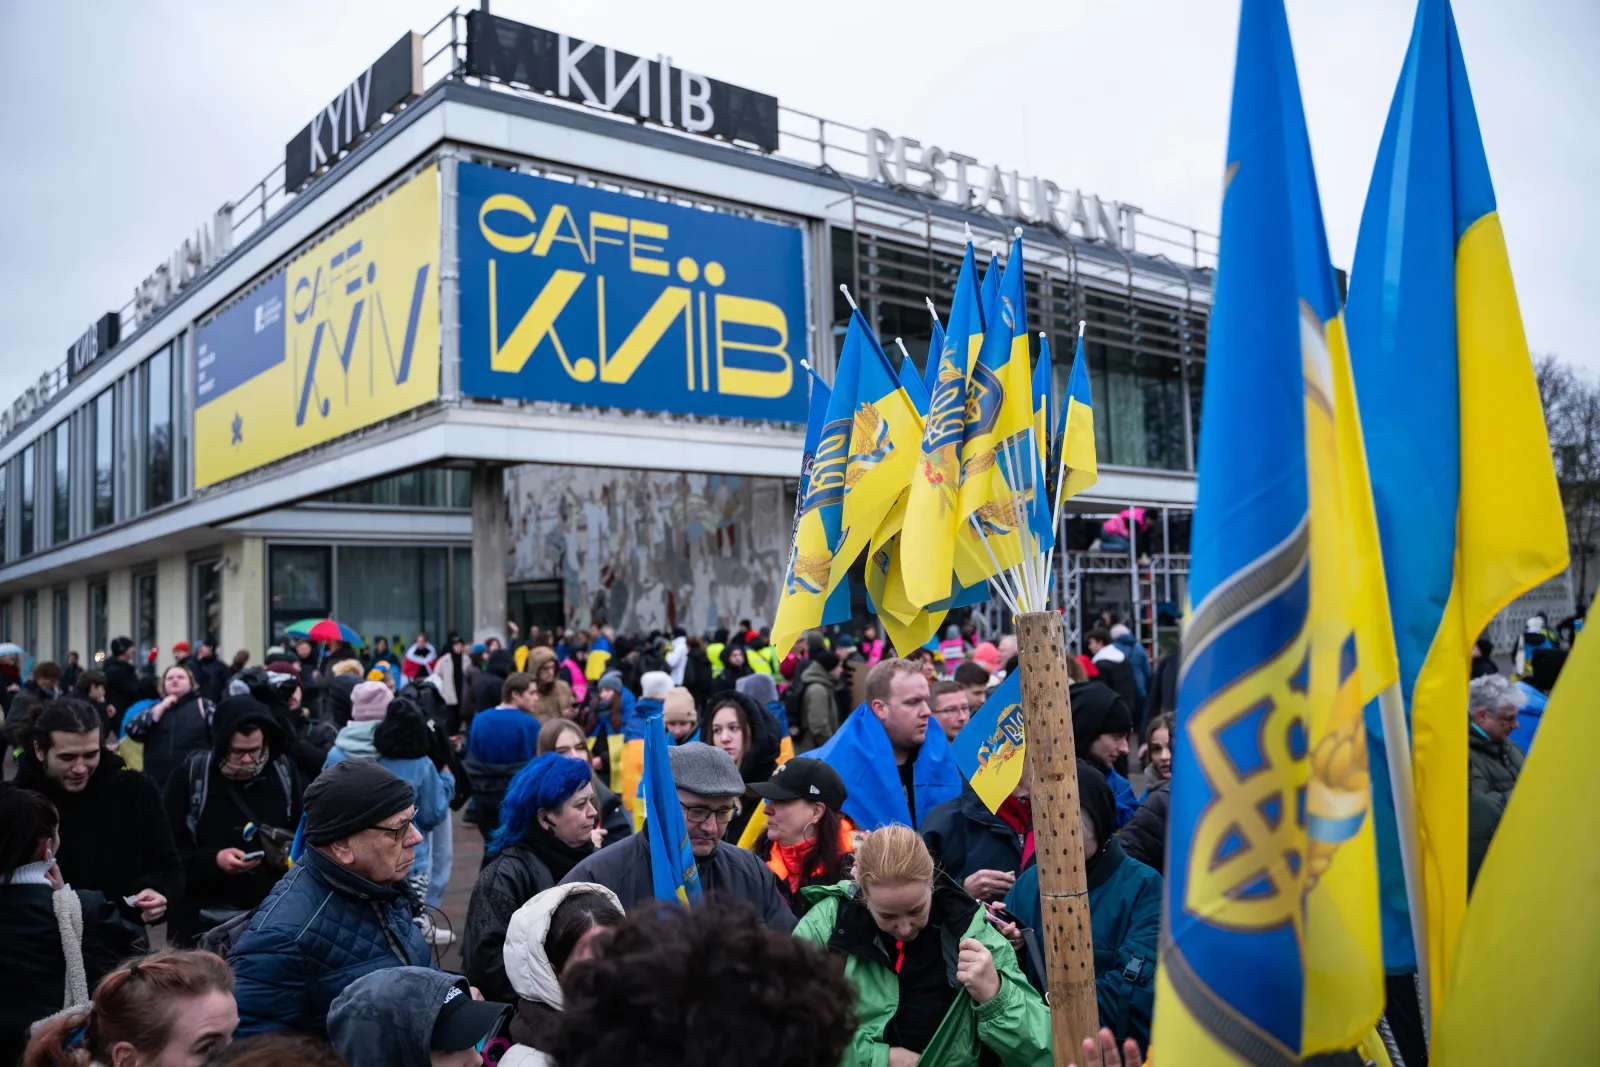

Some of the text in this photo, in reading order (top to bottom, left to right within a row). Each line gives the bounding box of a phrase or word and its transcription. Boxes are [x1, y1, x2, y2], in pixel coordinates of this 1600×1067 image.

[310, 65, 373, 172] KYIV
[558, 34, 714, 132] КИЇВ
[478, 193, 670, 277] CAFE
[867, 127, 1143, 251] RESTAURANT
[292, 239, 363, 325] CAFE
[488, 256, 793, 399] КИЇВ
[294, 261, 431, 427] KYIV
